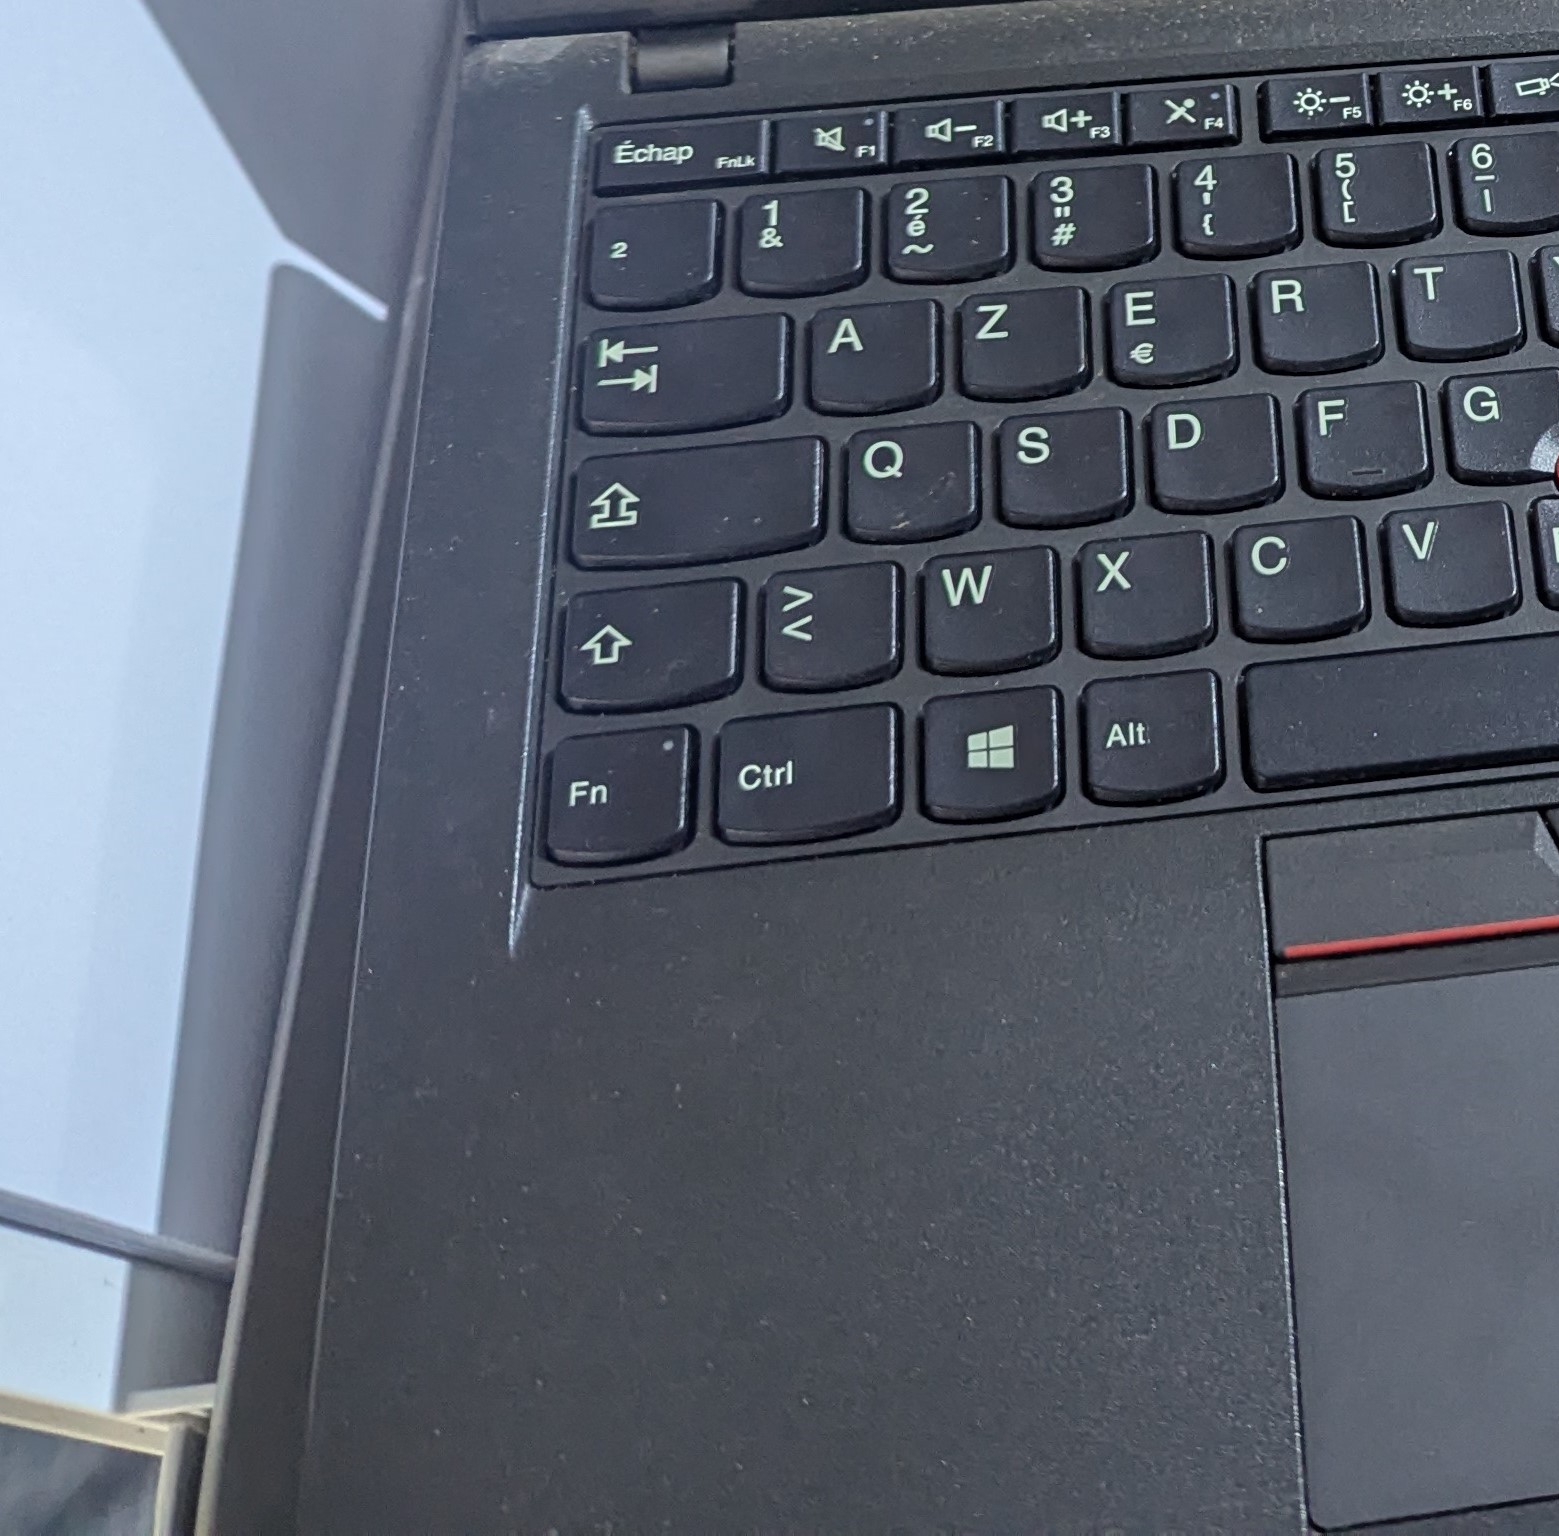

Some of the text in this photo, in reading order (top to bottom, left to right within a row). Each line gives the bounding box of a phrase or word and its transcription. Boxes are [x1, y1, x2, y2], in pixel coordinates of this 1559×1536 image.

[1343, 107, 1362, 119] F5
[1454, 99, 1472, 111] F6
[1090, 126, 1110, 138] F3
[1205, 117, 1224, 129] F4
[615, 140, 693, 164] Échap
[857, 146, 875, 157] F1
[973, 135, 993, 147] F2
[717, 156, 754, 168] FnLk
[1336, 153, 1355, 178] 5
[1472, 144, 1492, 168] 6
[1051, 177, 1073, 203] 3
[1194, 165, 1217, 190] 4
[763, 200, 778, 226] 1
[906, 188, 928, 214] 2
[907, 215, 925, 236] é
[1272, 280, 1304, 313] R
[1414, 267, 1443, 300] T
[976, 304, 1008, 339] Z
[1125, 292, 1155, 325] E
[828, 319, 863, 353] A
[1464, 386, 1499, 421] G
[1318, 400, 1344, 435] F
[1167, 414, 1201, 449] D
[1018, 427, 1049, 463] S
[864, 441, 903, 478] Q
[1403, 522, 1438, 559] V
[1252, 537, 1286, 575] C
[1097, 552, 1131, 591] X
[942, 566, 992, 606] W
[1107, 722, 1145, 748] Alt
[739, 761, 792, 790] Ctrl
[570, 781, 607, 806] Fn
